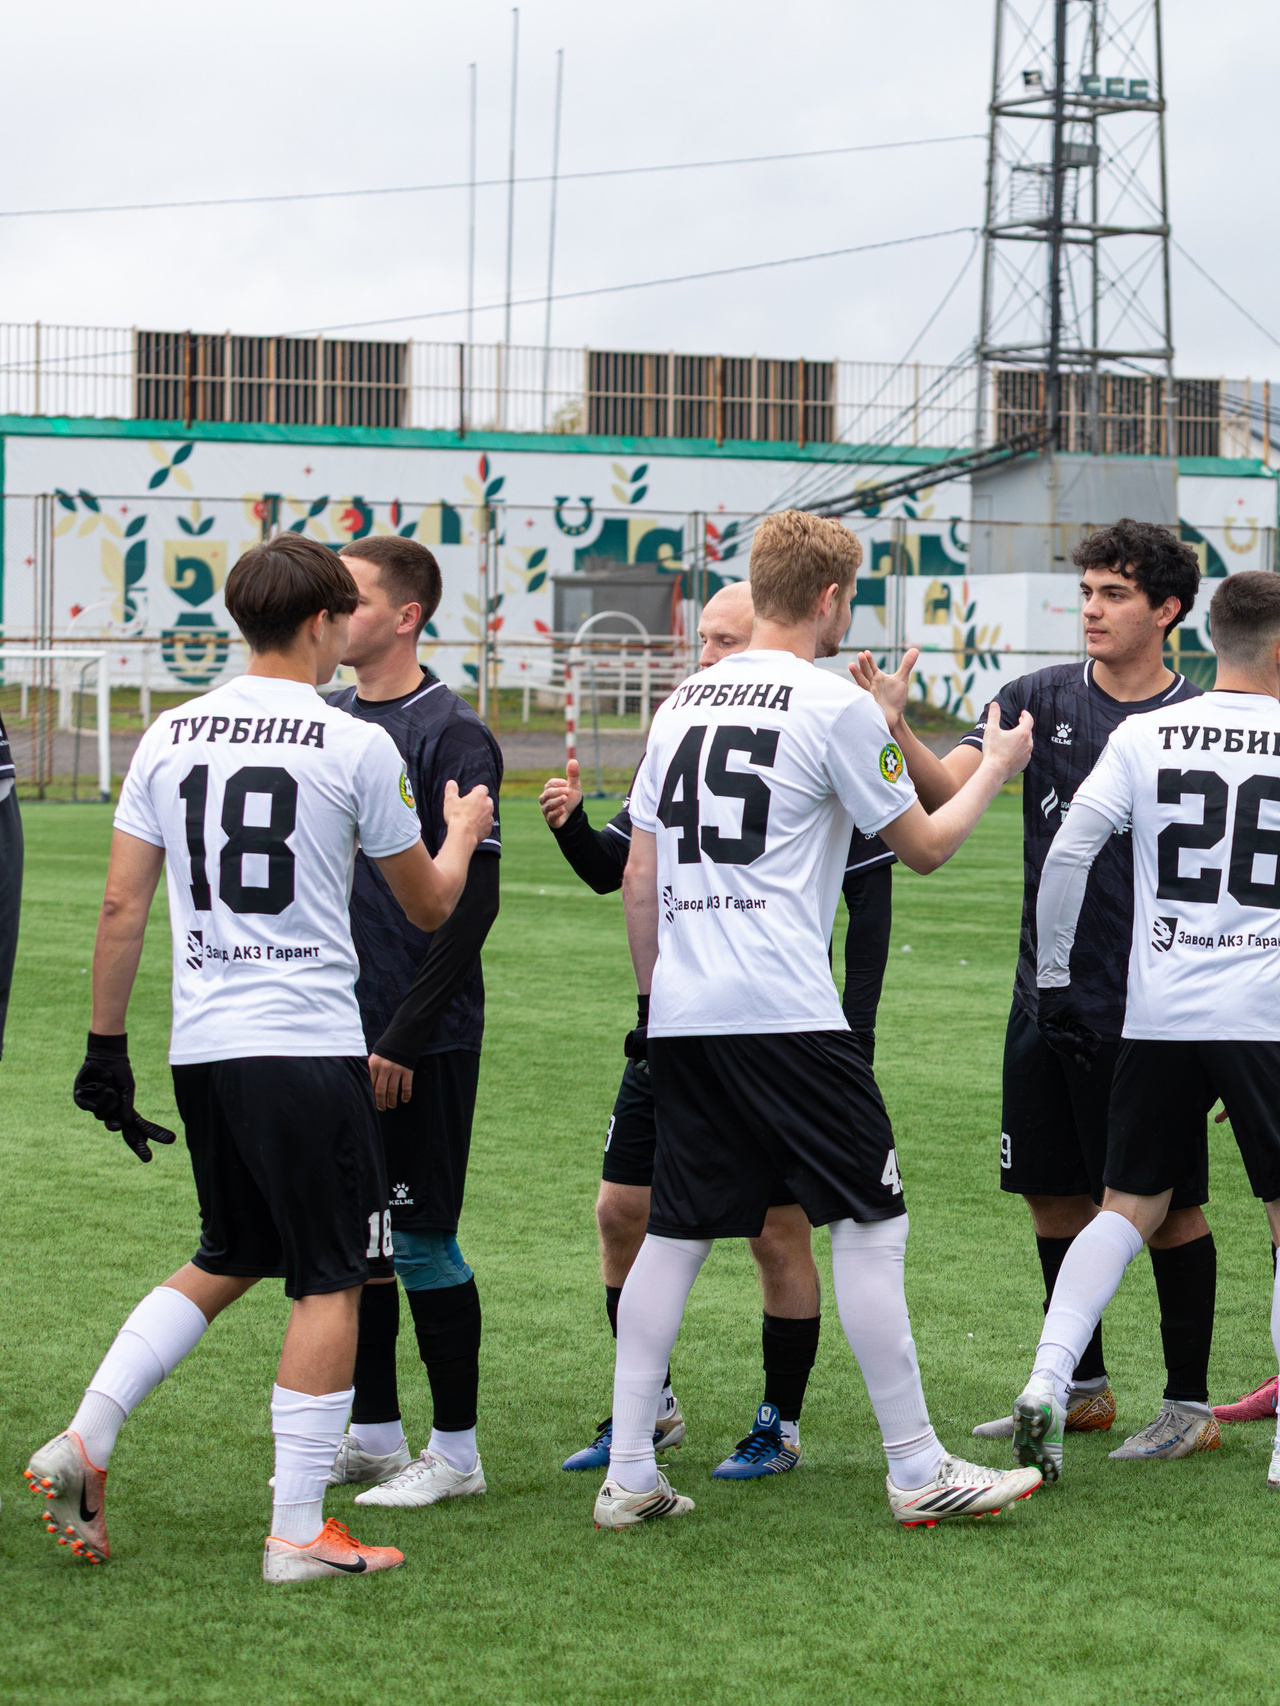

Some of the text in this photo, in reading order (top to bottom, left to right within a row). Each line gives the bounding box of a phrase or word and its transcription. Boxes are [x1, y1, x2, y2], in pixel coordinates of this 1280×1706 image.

[672, 684, 794, 712] ТУРБИНА
[170, 716, 326, 749] ТУРБИНА
[656, 725, 781, 866] 45
[179, 764, 298, 915] 18
[725, 896, 767, 912] Гарант
[233, 946, 261, 960] АКЗ
[267, 946, 320, 961] Гарант
[1178, 931, 1214, 949] Завод
[1217, 934, 1243, 947] АКЗ
[366, 1209, 394, 1258] 18
